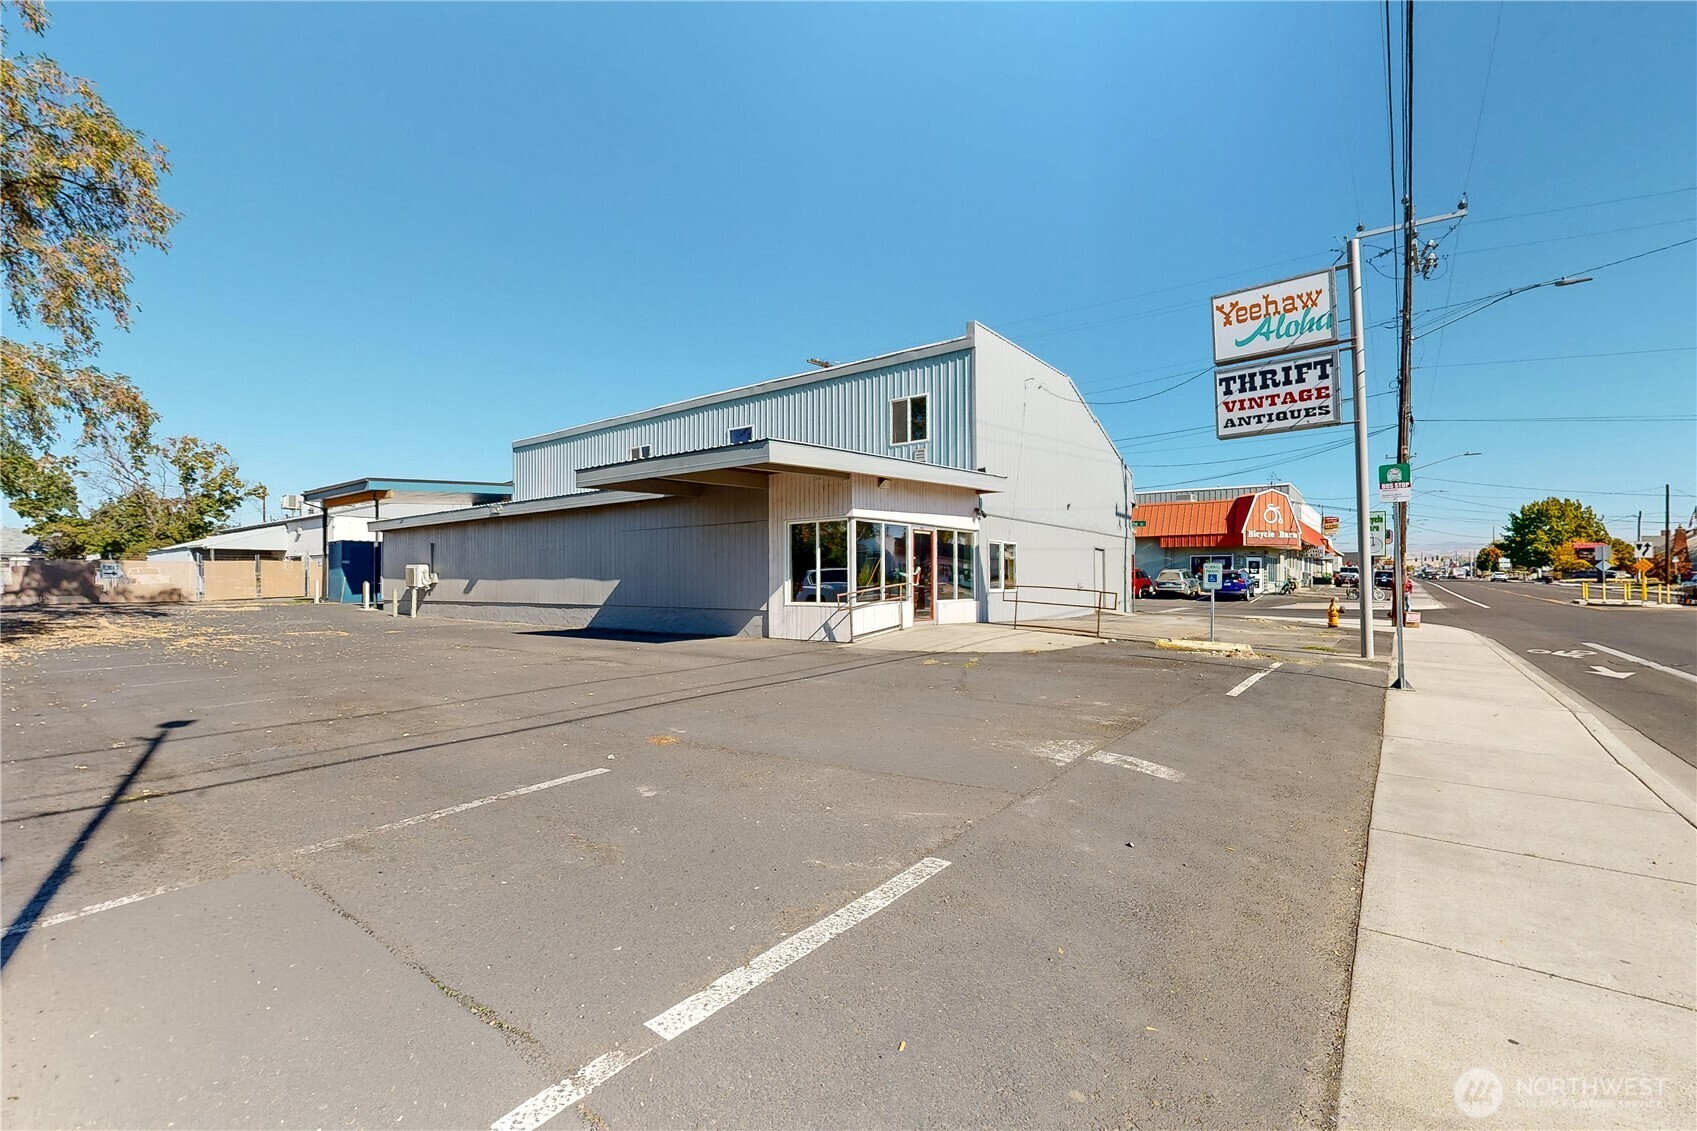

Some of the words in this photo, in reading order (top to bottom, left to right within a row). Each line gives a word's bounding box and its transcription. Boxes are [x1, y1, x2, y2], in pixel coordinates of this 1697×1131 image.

[1216, 288, 1323, 327] Yeehaw
[1235, 307, 1333, 347] Aloha
[1219, 358, 1333, 396] THRIFT
[1223, 386, 1330, 413] VINTAGE
[1223, 405, 1331, 429] ANTIQUES
[1248, 529, 1275, 539] Bicycle
[1279, 530, 1298, 538] Barn
